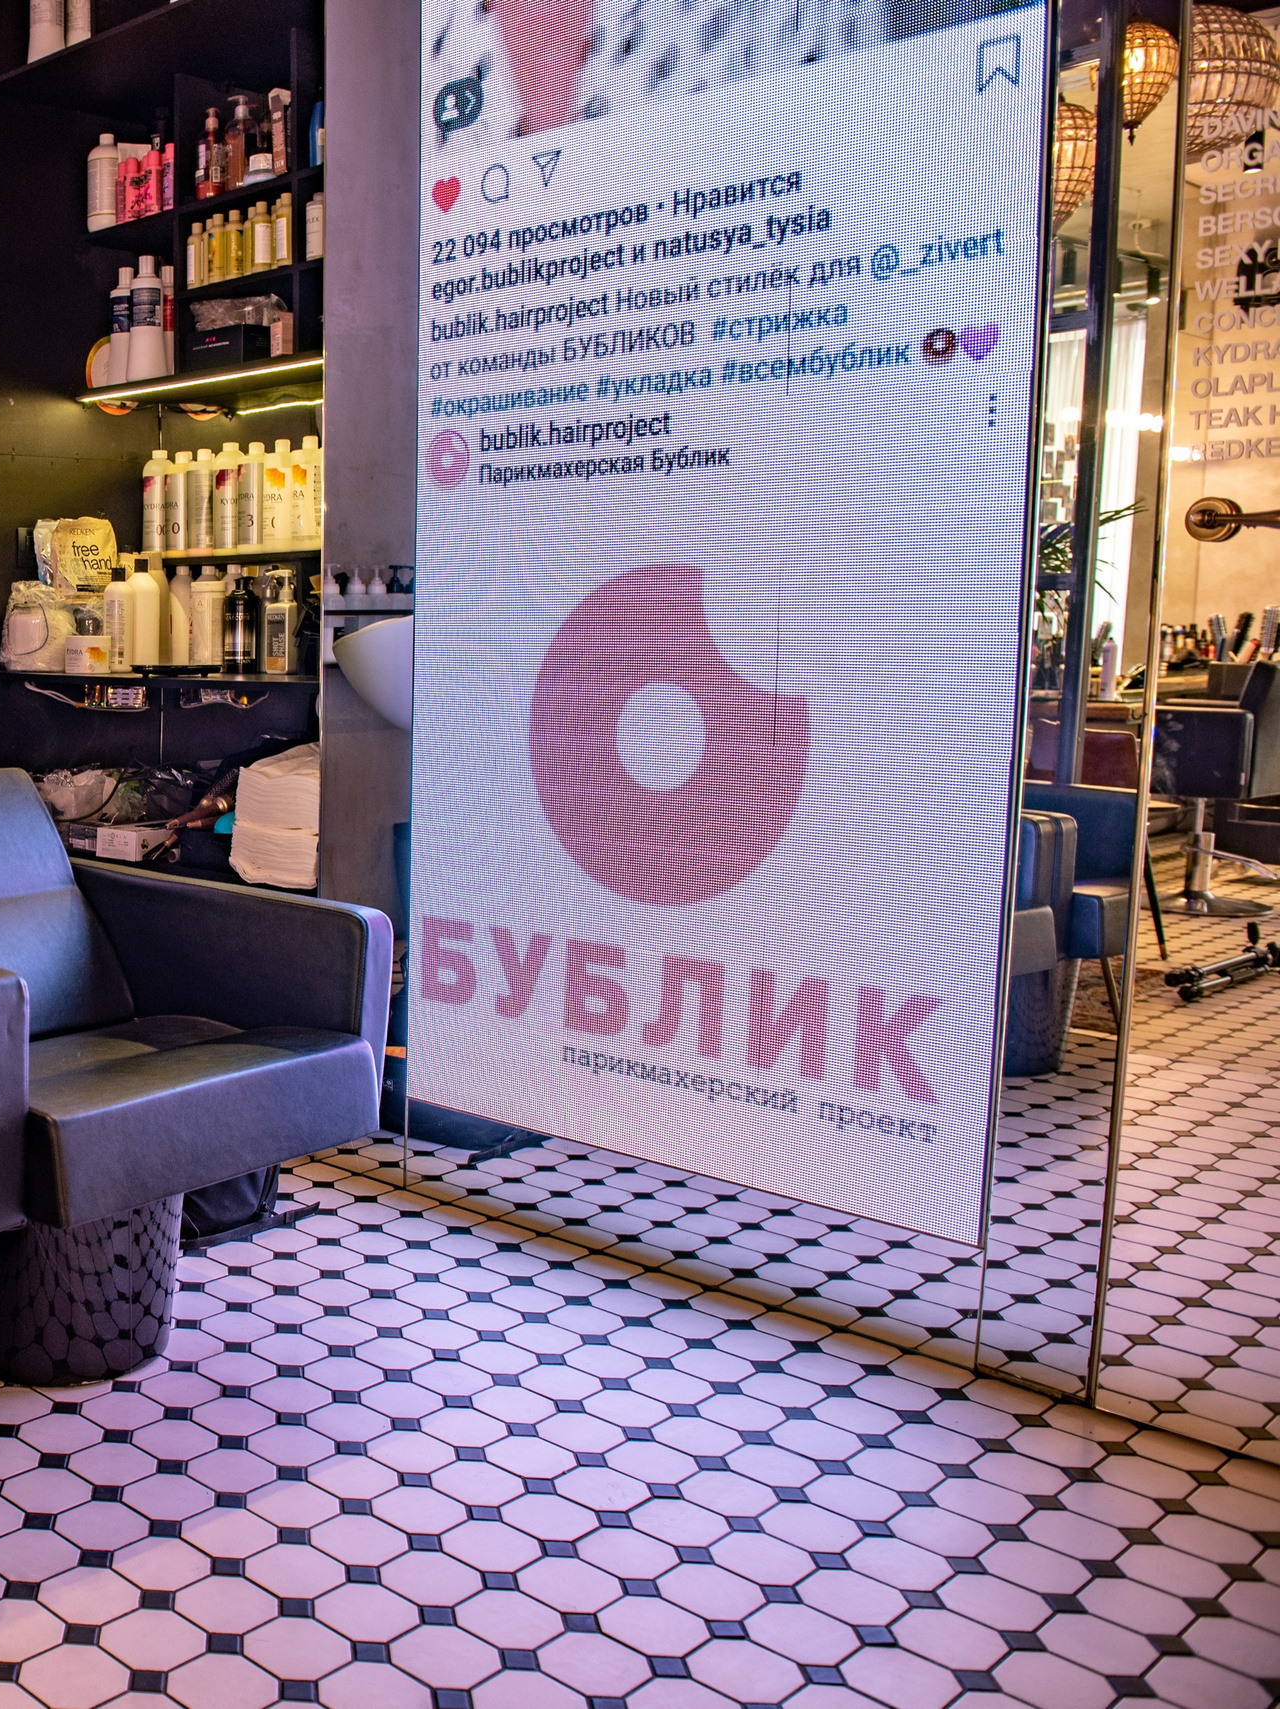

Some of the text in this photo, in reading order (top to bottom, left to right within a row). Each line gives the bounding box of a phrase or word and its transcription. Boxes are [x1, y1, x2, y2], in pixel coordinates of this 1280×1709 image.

[1199, 173, 1280, 205] SECR
[433, 171, 802, 264] 22 094 просмотров Нравится
[433, 205, 830, 304] egor.bublikproject и natusya_tysia
[1196, 239, 1272, 269] SEXY
[432, 229, 1004, 342] bublik.hairproject Новый стилёк для @_zivert
[1194, 305, 1280, 333] CONC
[430, 304, 848, 380] от команды БУБЛИКОВ #стрижка
[431, 342, 909, 417] #окрашивание #укладка #всембублик
[480, 412, 670, 452] bublik.hairproject
[1189, 405, 1262, 431] TEAK
[479, 445, 730, 487] Парикмахерская Бублик
[69, 528, 95, 536] REDKEN
[72, 541, 99, 557] free
[81, 555, 112, 571] hand
[420, 915, 944, 1104] БУБЛИК
[561, 1045, 939, 1146] парикмахерский проект
